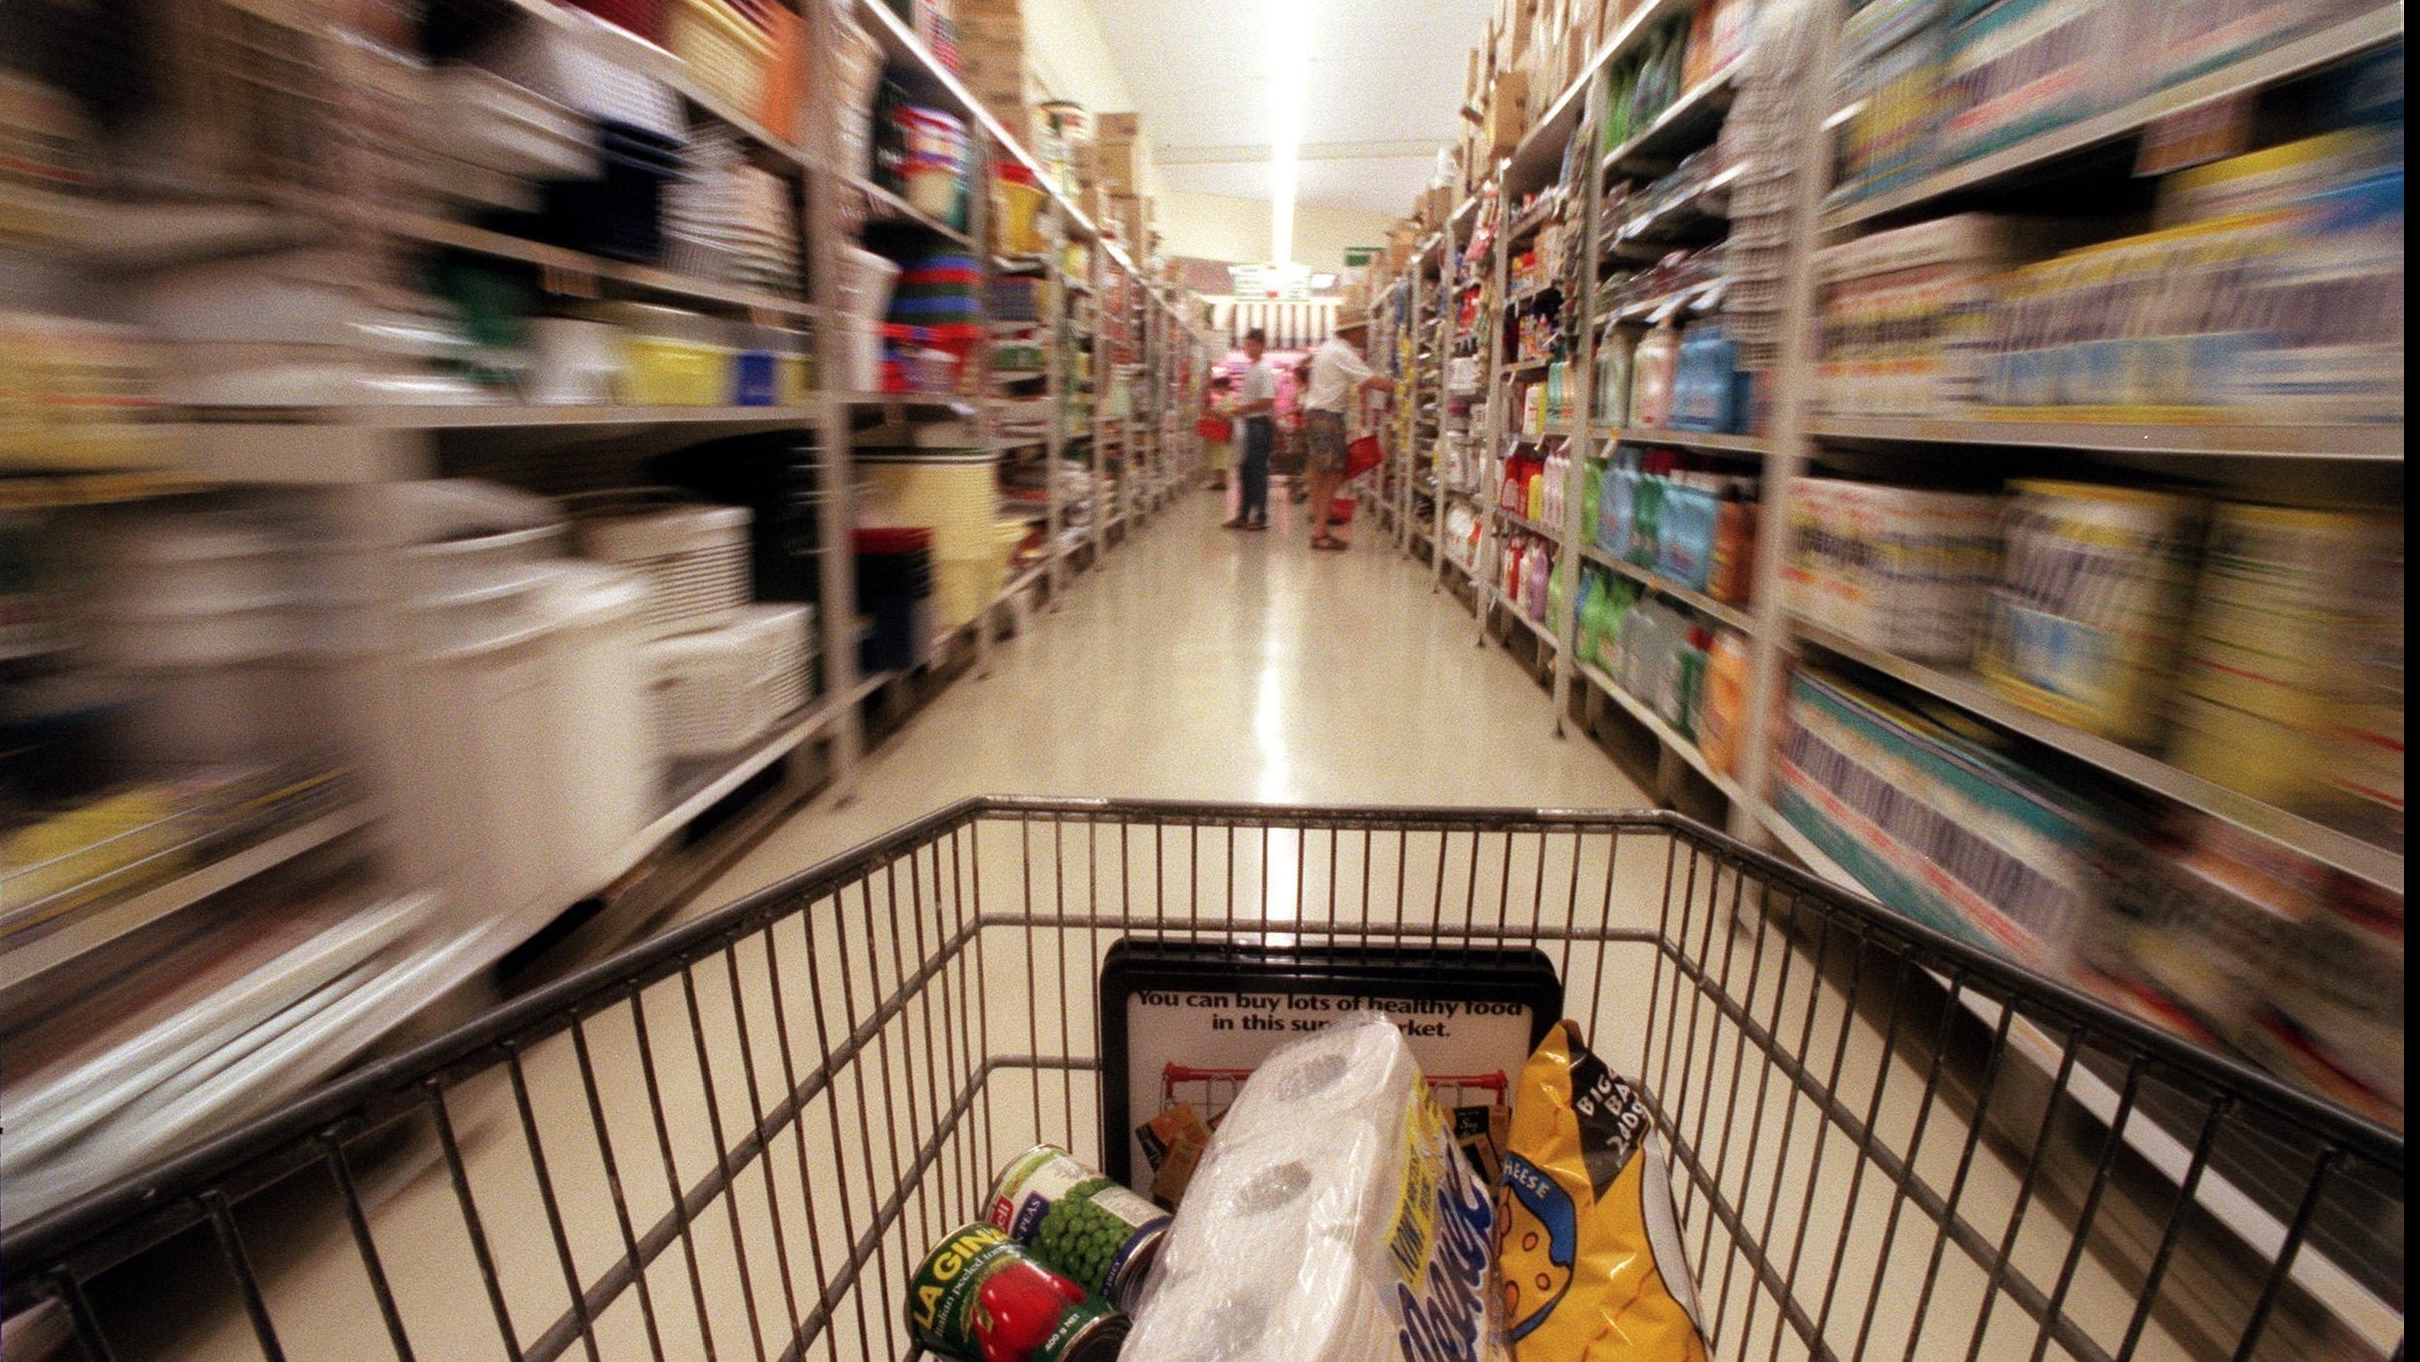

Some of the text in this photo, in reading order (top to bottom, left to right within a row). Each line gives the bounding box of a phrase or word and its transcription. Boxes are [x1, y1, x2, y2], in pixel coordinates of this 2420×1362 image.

[1136, 991, 1523, 1017] You can buy lots of healthy food
[1211, 1013, 1234, 1031] in
[1241, 1015, 1286, 1032] this
[1502, 1158, 1550, 1199] HEESE
[1398, 1138, 1493, 1362] leenex
[952, 1256, 984, 1296] peeled
[913, 1284, 945, 1331] LA
